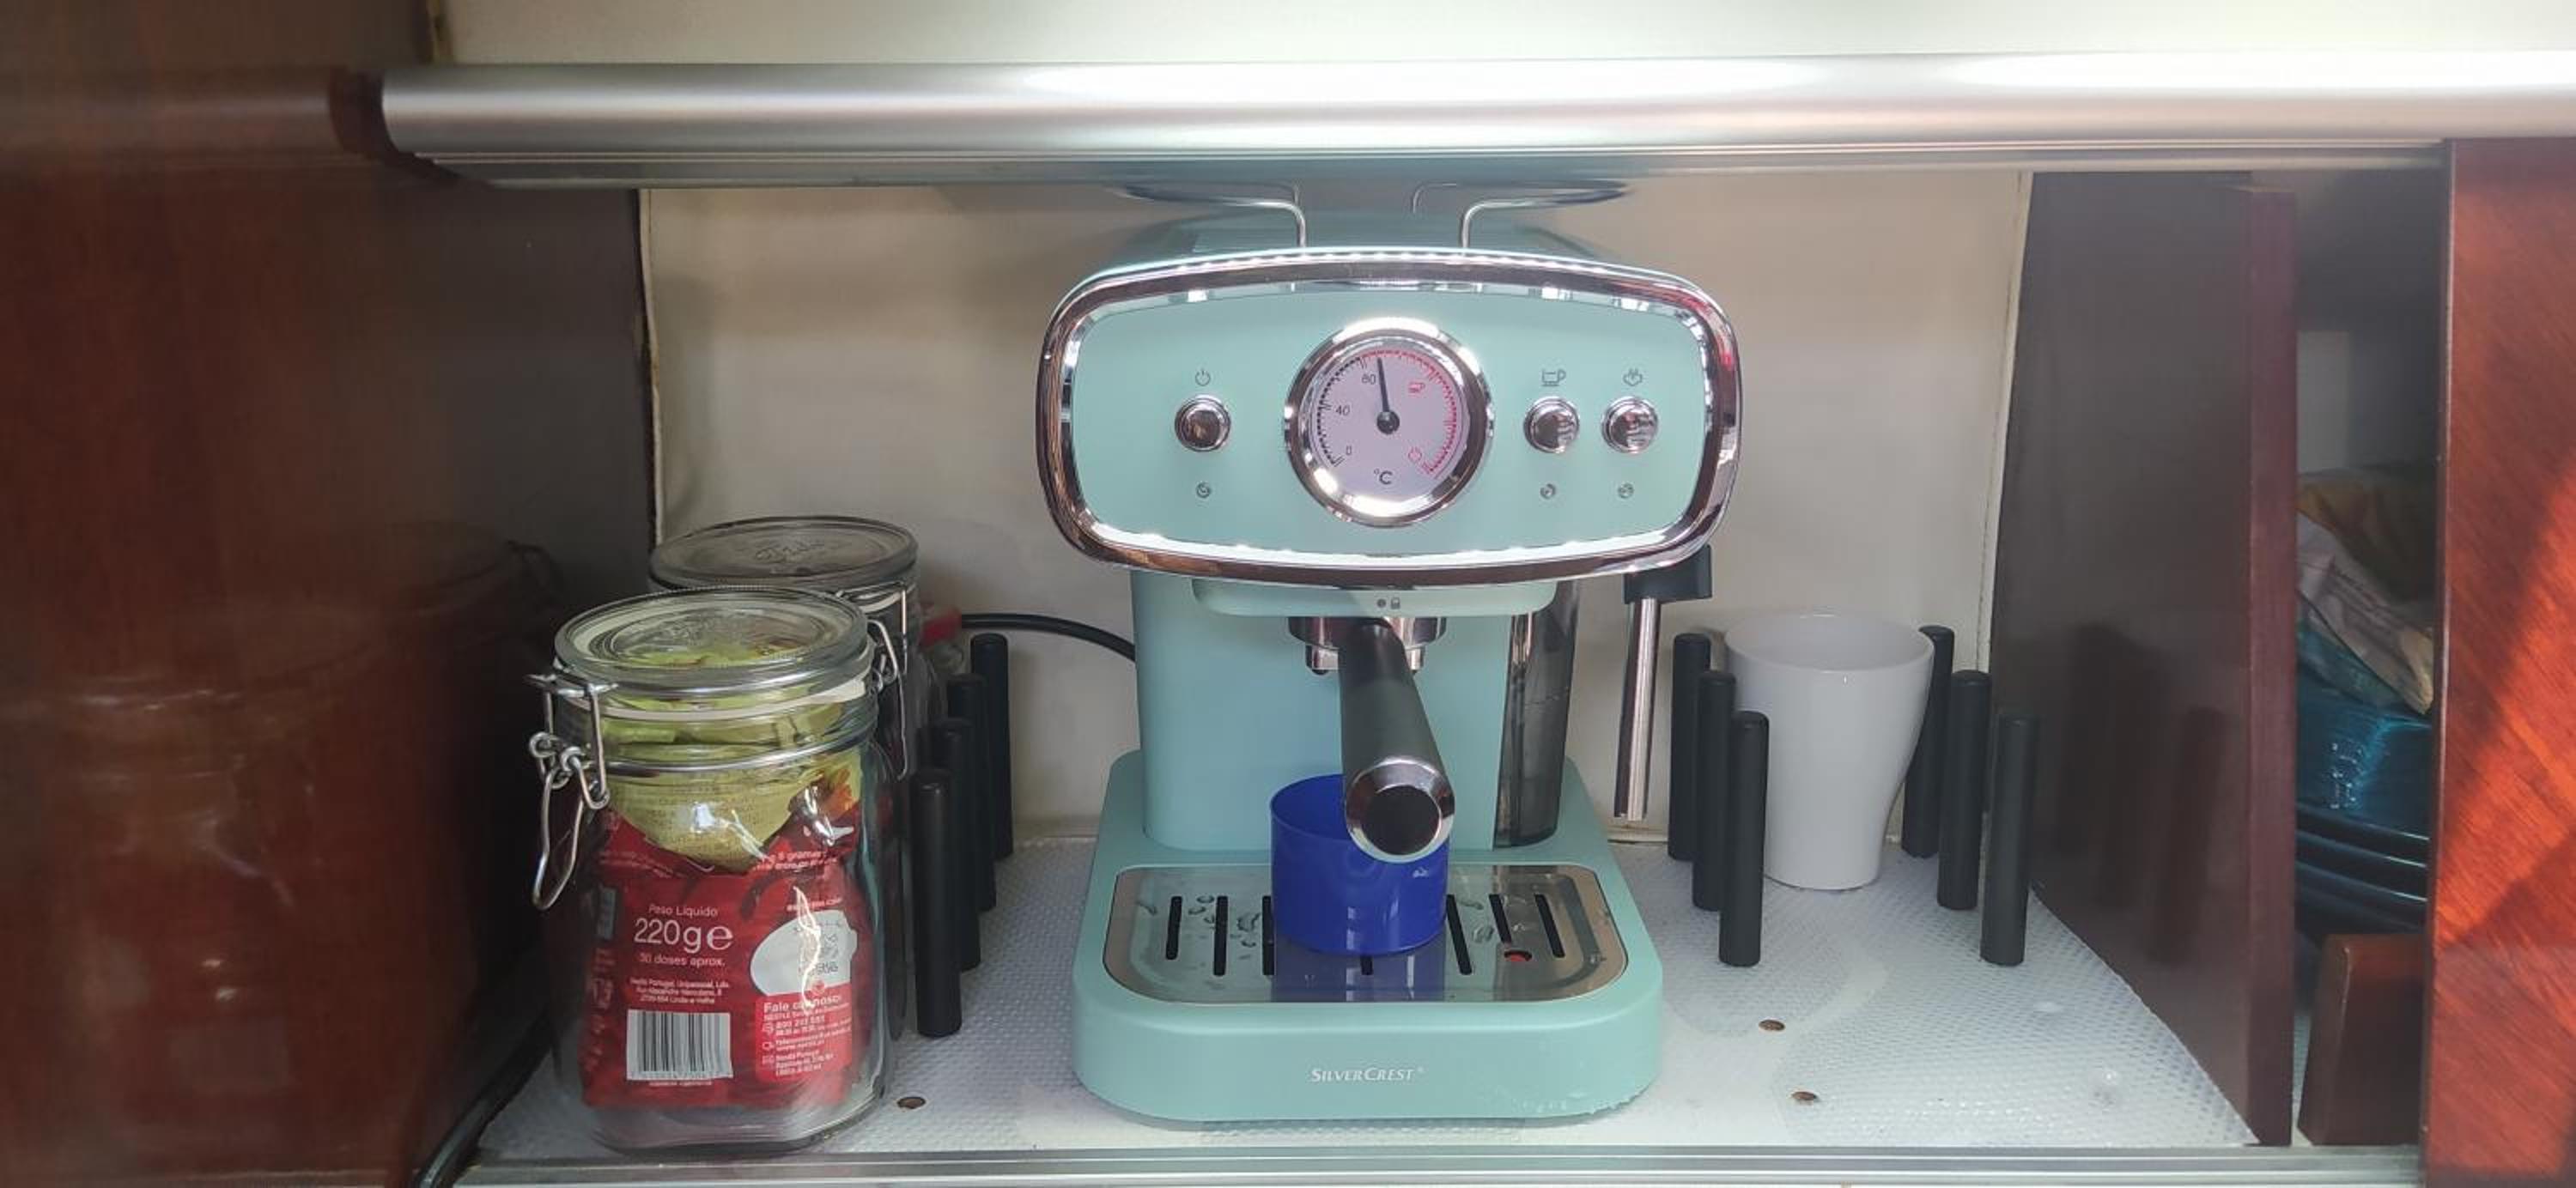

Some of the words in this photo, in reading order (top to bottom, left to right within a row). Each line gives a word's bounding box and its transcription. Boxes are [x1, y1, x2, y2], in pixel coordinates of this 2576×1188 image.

[1361, 373, 1376, 385] 80
[1335, 404, 1351, 416] 40
[1346, 446, 1352, 456] 0
[1374, 469, 1394, 485] °C
[690, 957, 726, 968] aprox.
[763, 1001, 789, 1014] Fale
